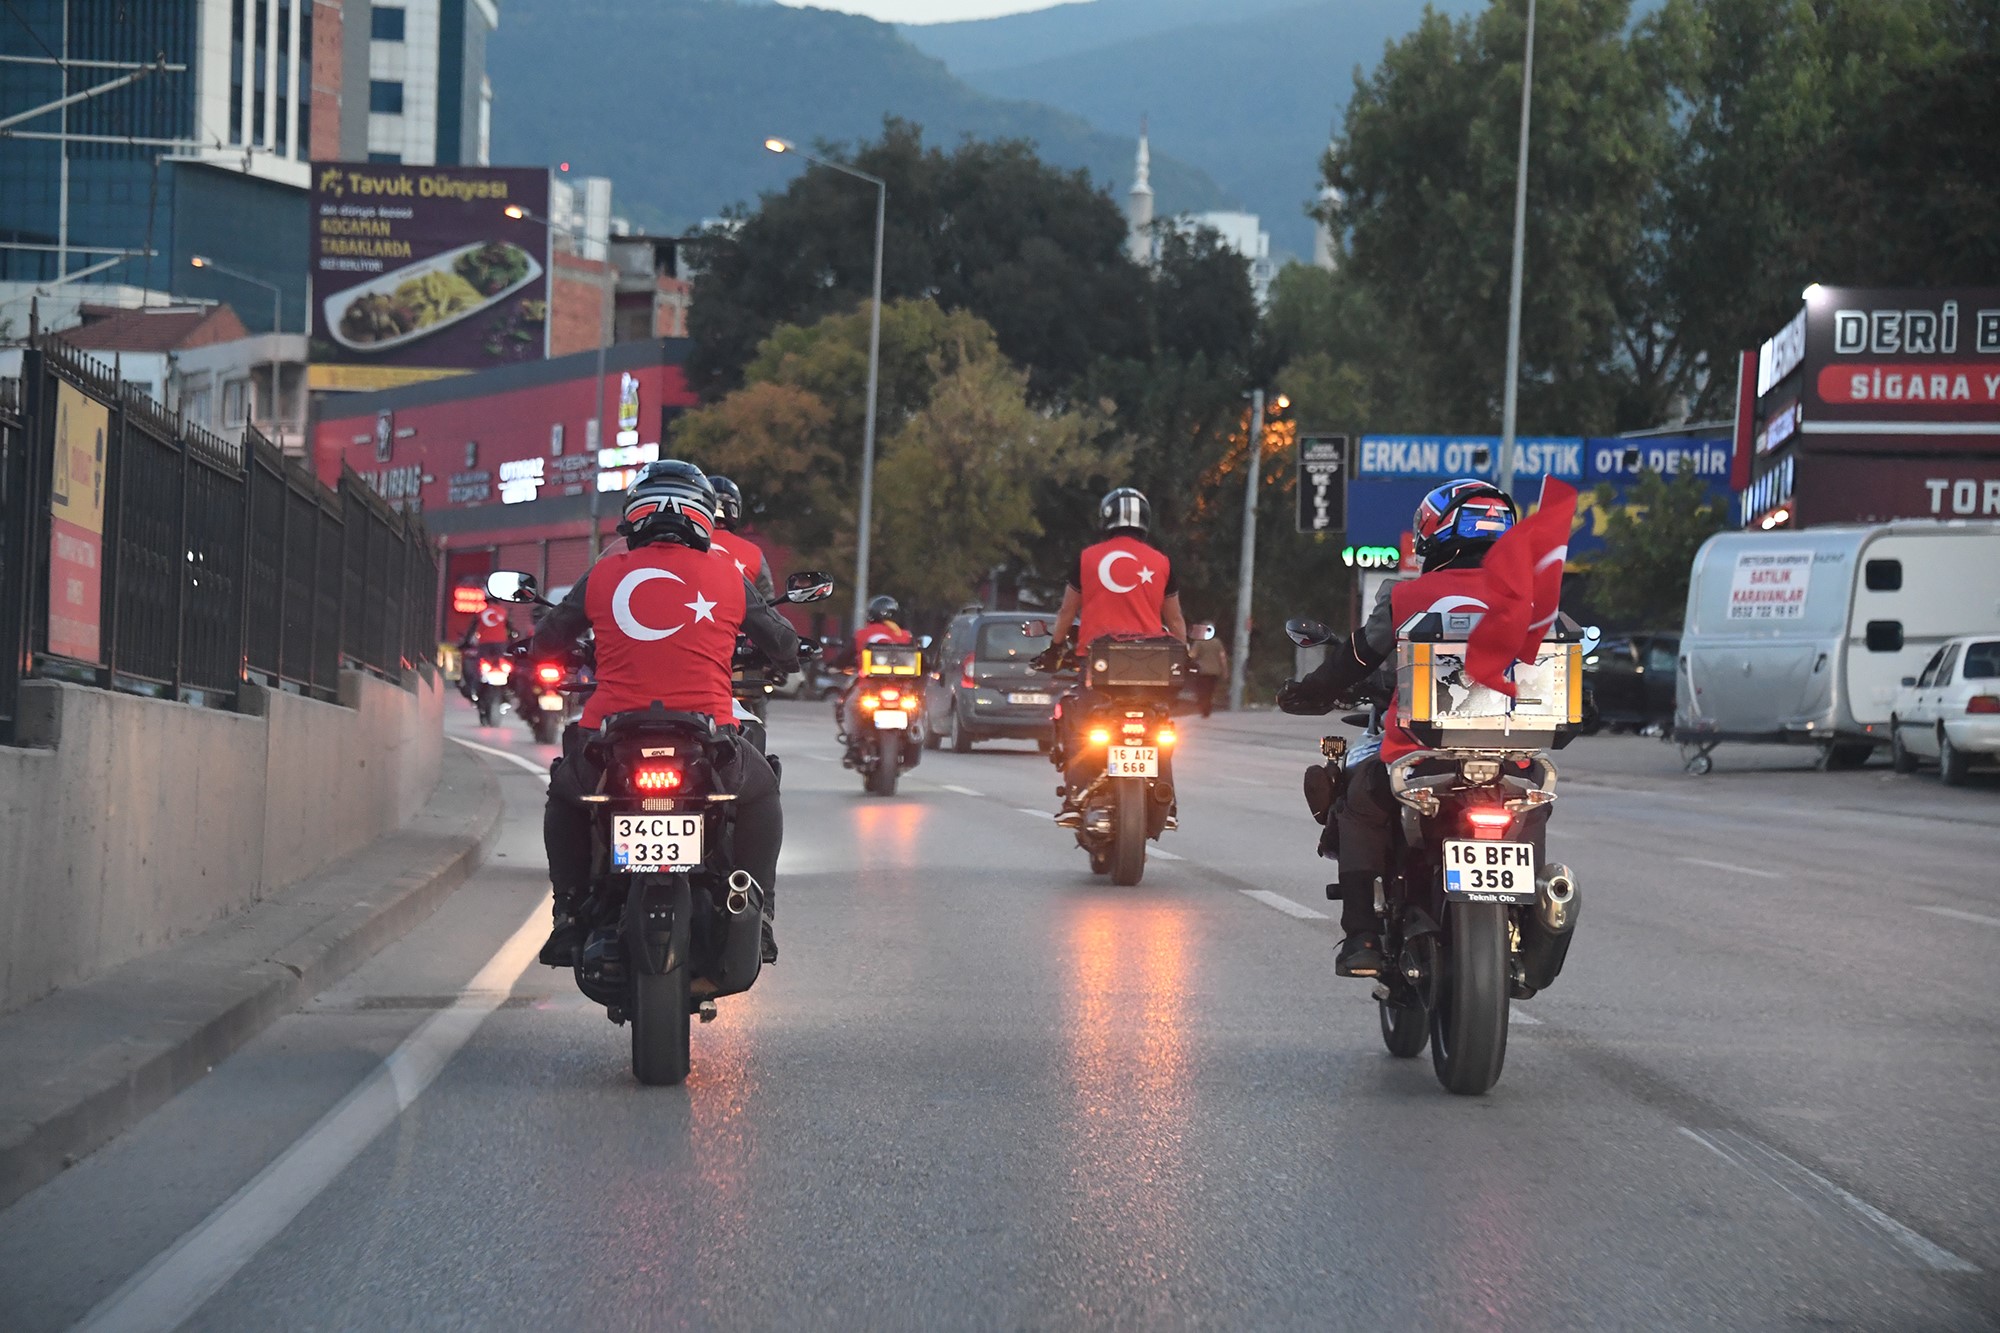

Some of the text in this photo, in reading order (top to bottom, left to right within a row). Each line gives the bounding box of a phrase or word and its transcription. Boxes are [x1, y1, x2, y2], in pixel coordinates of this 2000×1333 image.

[349, 172, 508, 201] Tavuk Dünyası
[320, 218, 391, 236] KOCAMAN
[320, 238, 412, 258] TABAKLARDA
[1835, 300, 1958, 353] DERİ
[1851, 369, 1970, 400] SİGARA
[1361, 441, 1439, 473] ERKAN
[1649, 443, 1727, 475] DEMİR
[1750, 568, 1791, 585] SATILIK
[1732, 588, 1804, 604] KARAVANLAR
[1114, 749, 1126, 760] 16
[1123, 762, 1145, 773] 668
[617, 856, 627, 864] TR
[635, 843, 680, 861] 333
[1451, 845, 1530, 867] 16 BFH
[1449, 882, 1460, 890] TR
[1470, 869, 1514, 889] 358
[1468, 893, 1516, 903] Teknik Oto
